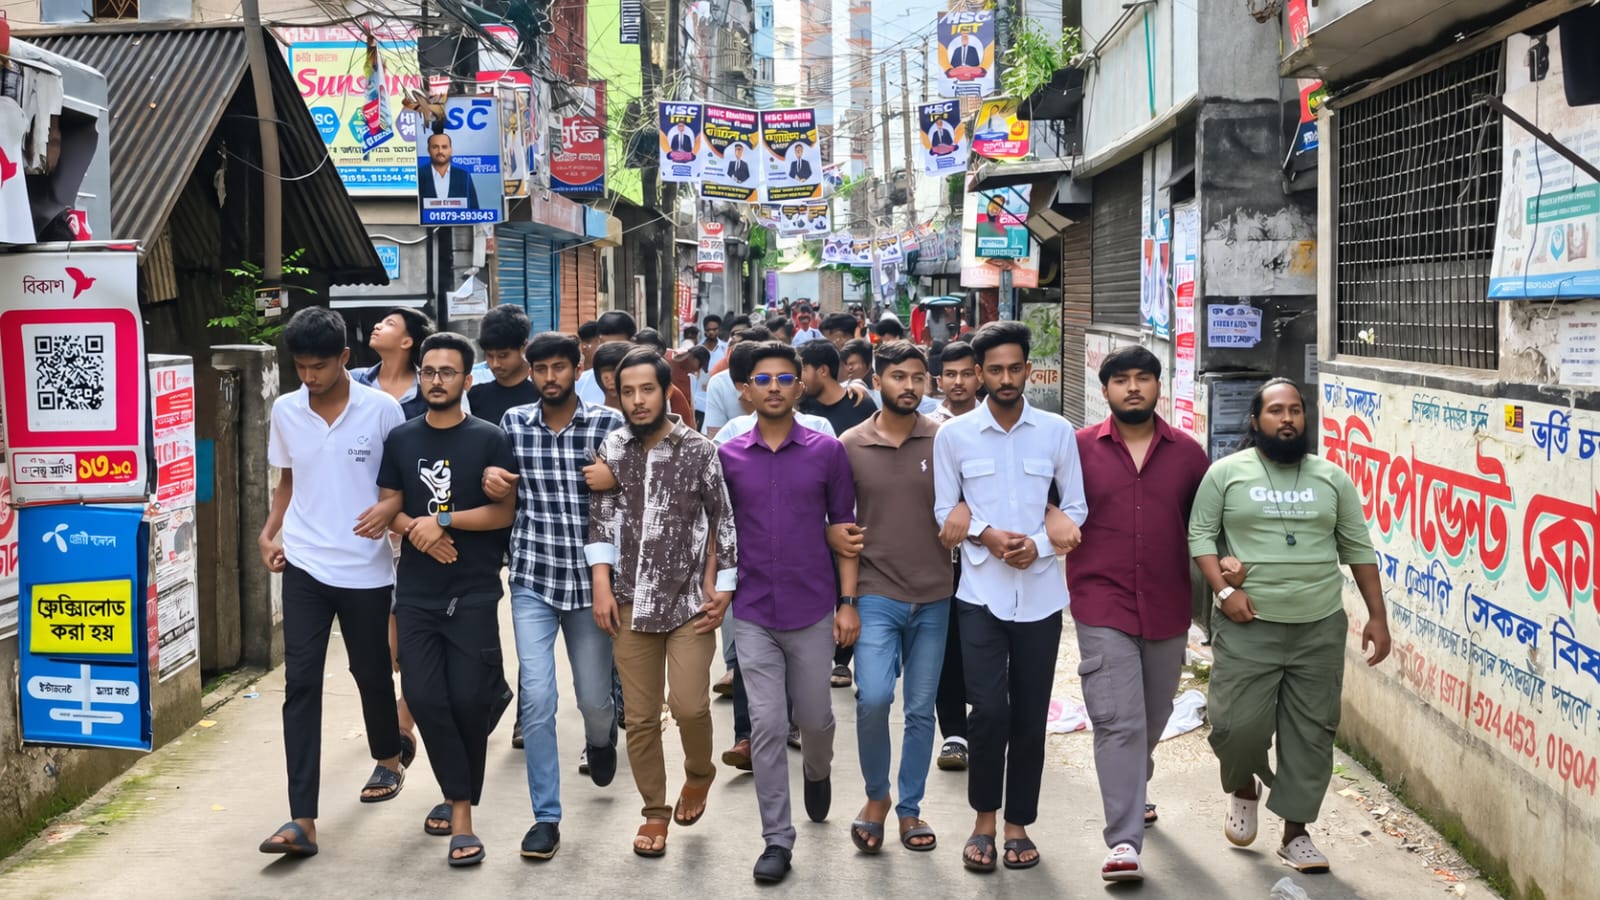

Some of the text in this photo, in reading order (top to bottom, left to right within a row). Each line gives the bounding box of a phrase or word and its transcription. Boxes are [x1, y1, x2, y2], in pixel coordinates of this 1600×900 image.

[23, 276, 65, 295] বিকাশ
[1530, 410, 1572, 462] ভর্তি
[50, 623, 115, 642] করা হয়
